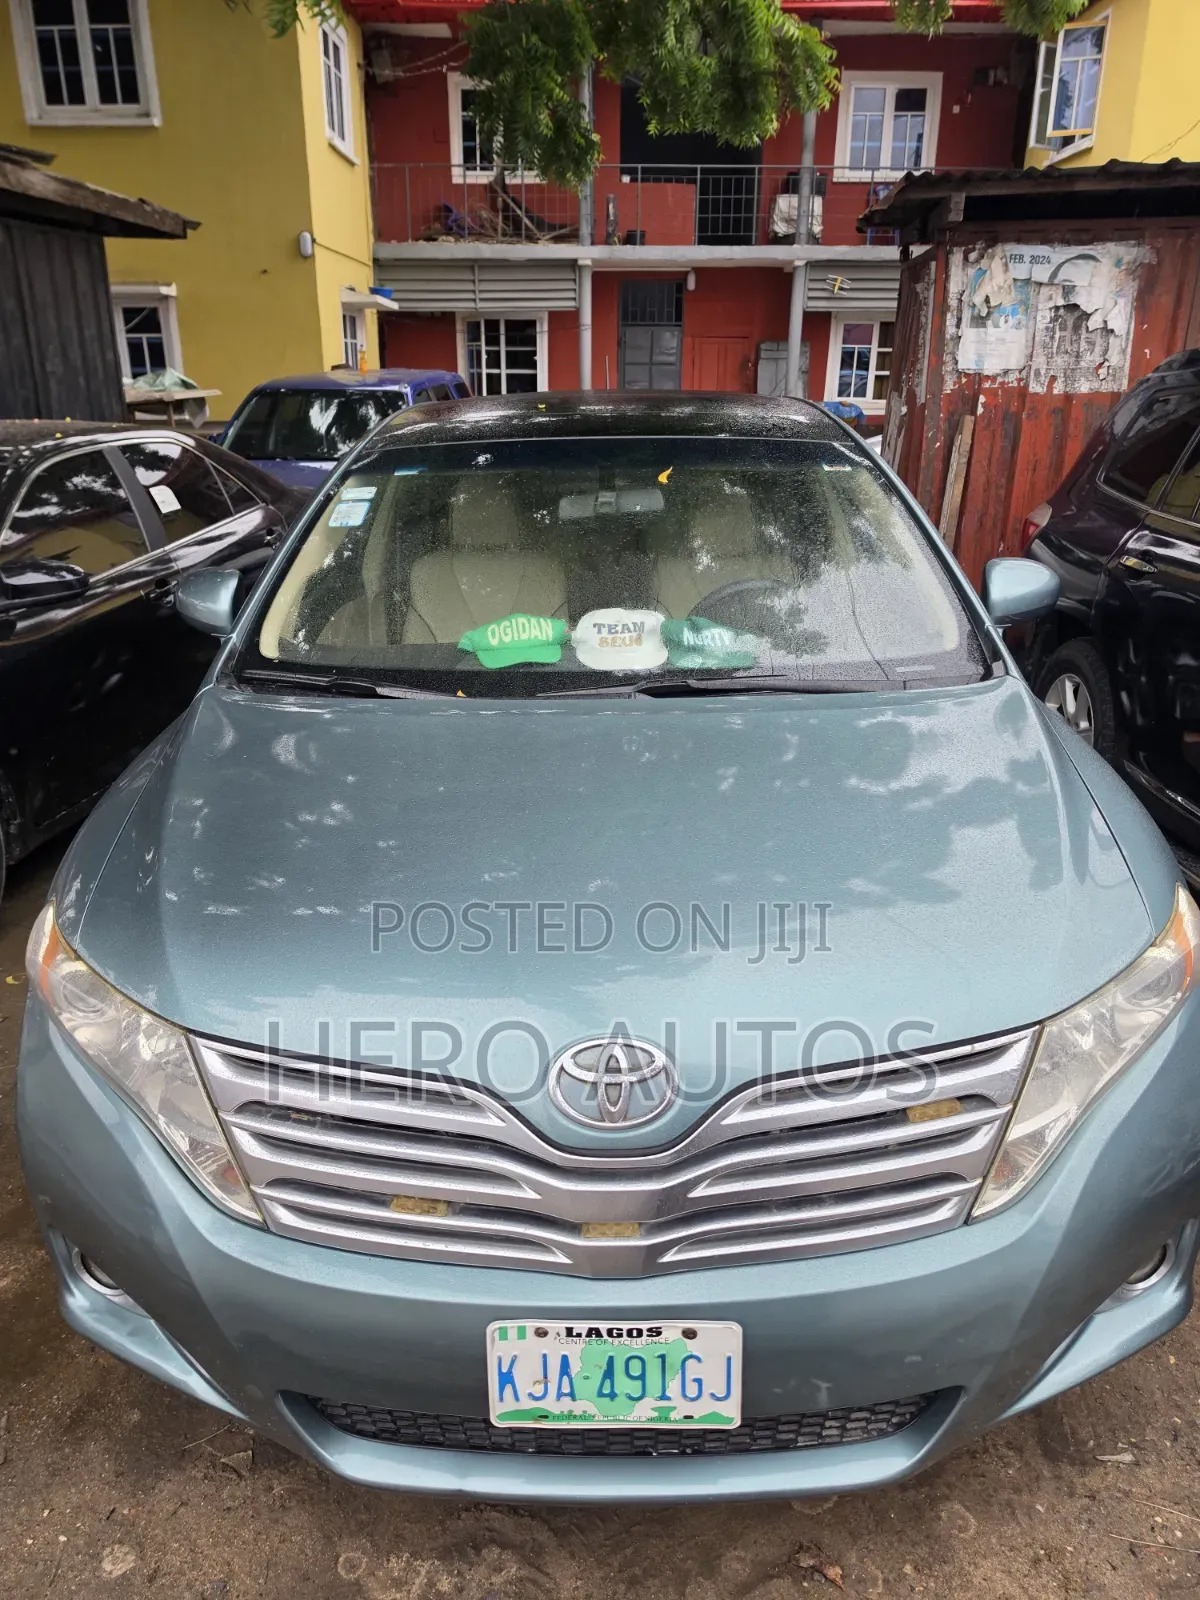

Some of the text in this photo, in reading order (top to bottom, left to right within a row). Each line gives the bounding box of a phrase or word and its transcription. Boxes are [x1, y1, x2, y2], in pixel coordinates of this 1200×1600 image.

[1009, 254, 1052, 265] FEB. 2024
[487, 617, 554, 646] OGIDAN
[592, 621, 646, 635] TEAM
[564, 1326, 664, 1339] LAGOS
[558, 1337, 670, 1347] CENTRE OF EXCELLENCE
